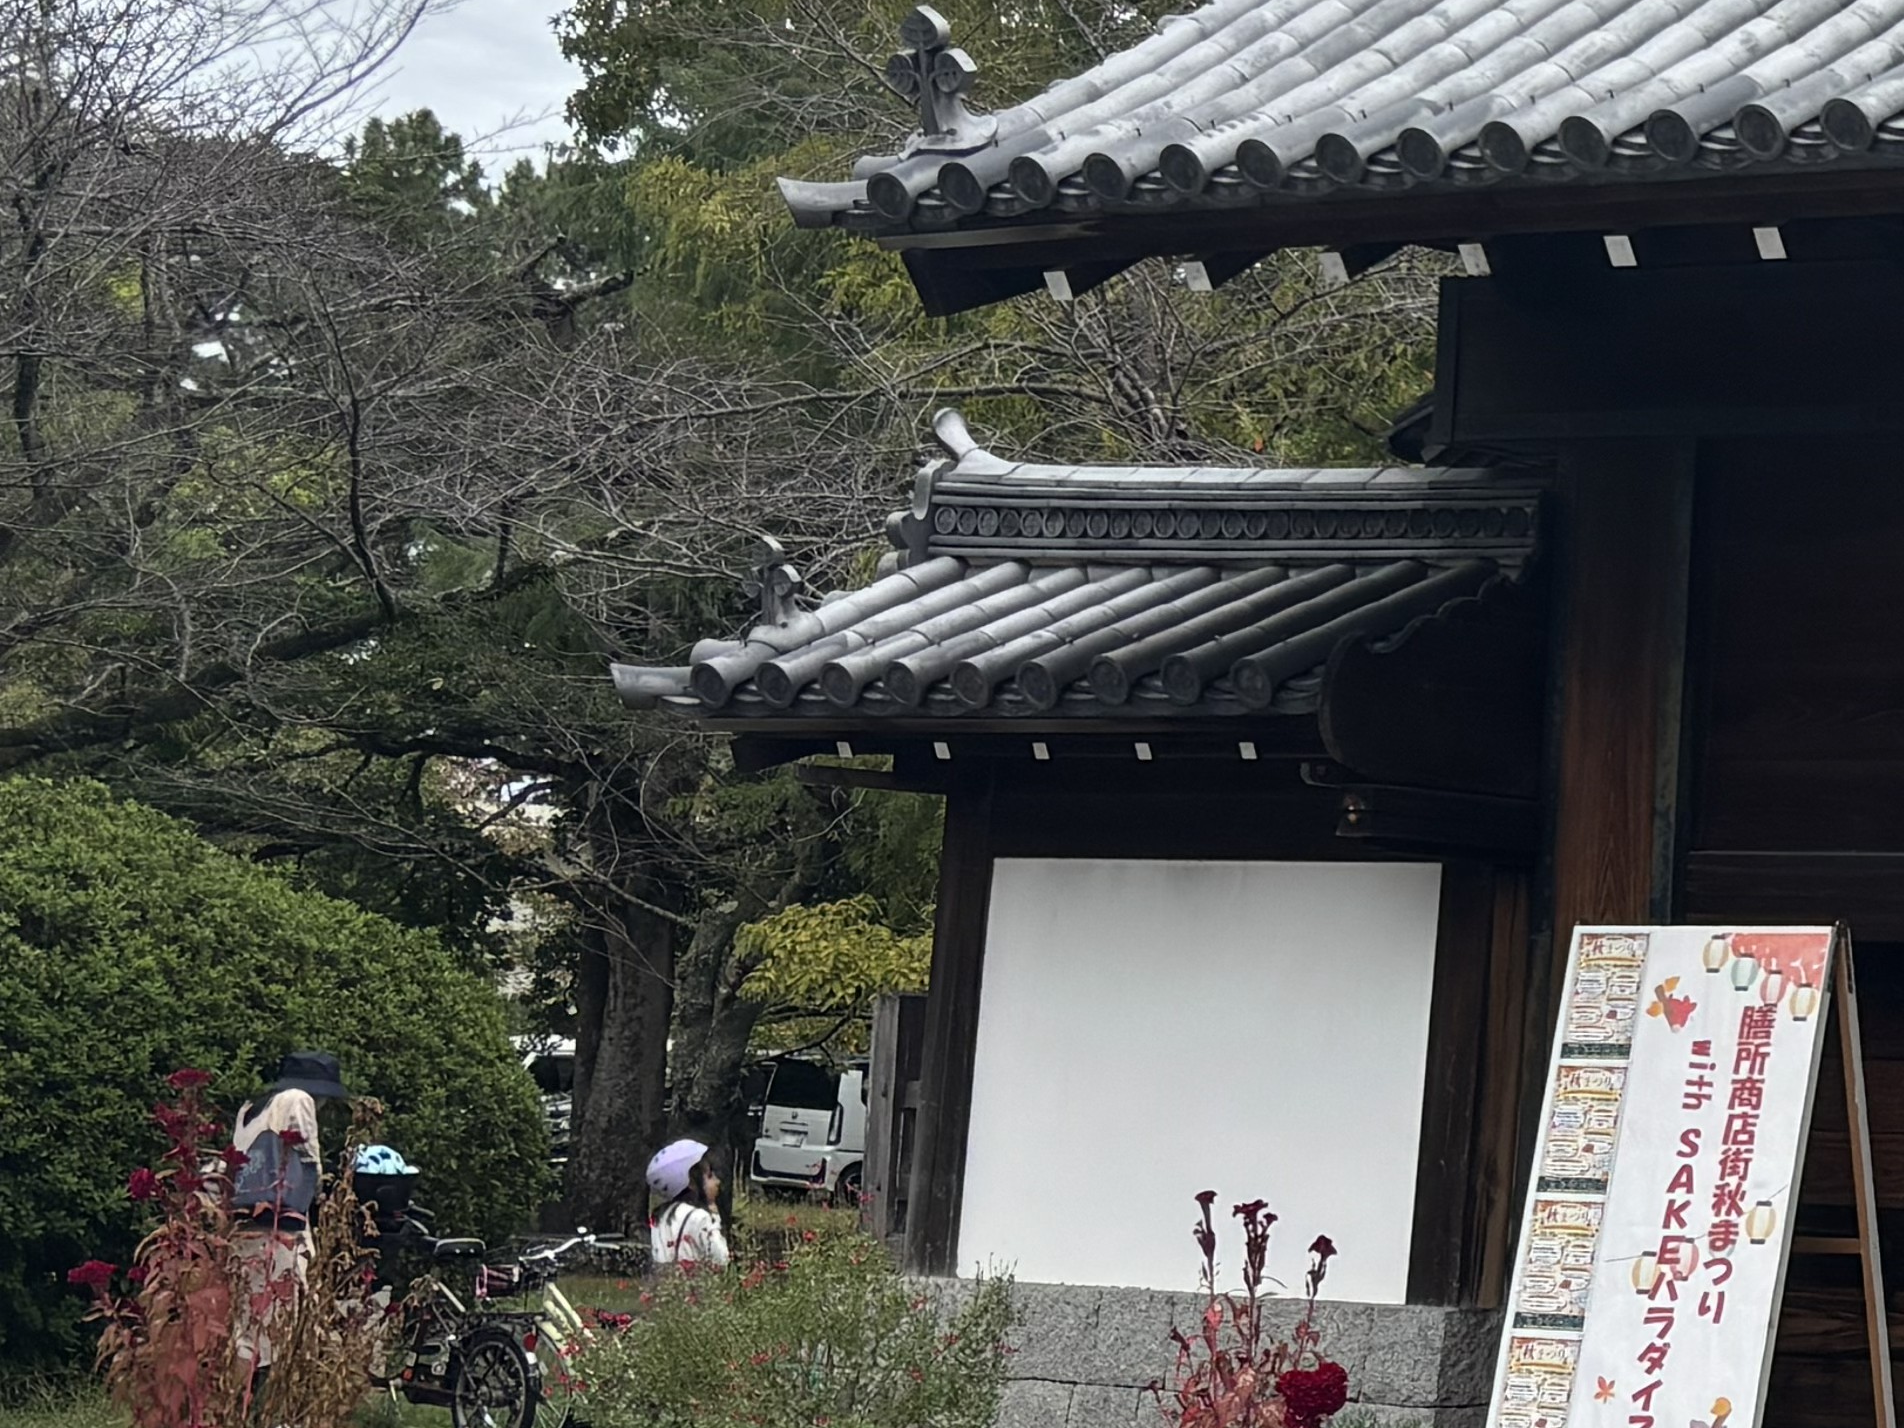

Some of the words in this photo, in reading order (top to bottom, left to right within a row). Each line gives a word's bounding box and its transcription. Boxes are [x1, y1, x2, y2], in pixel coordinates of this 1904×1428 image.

[1698, 1005, 1777, 1324] 膳所商店街秋まつり
